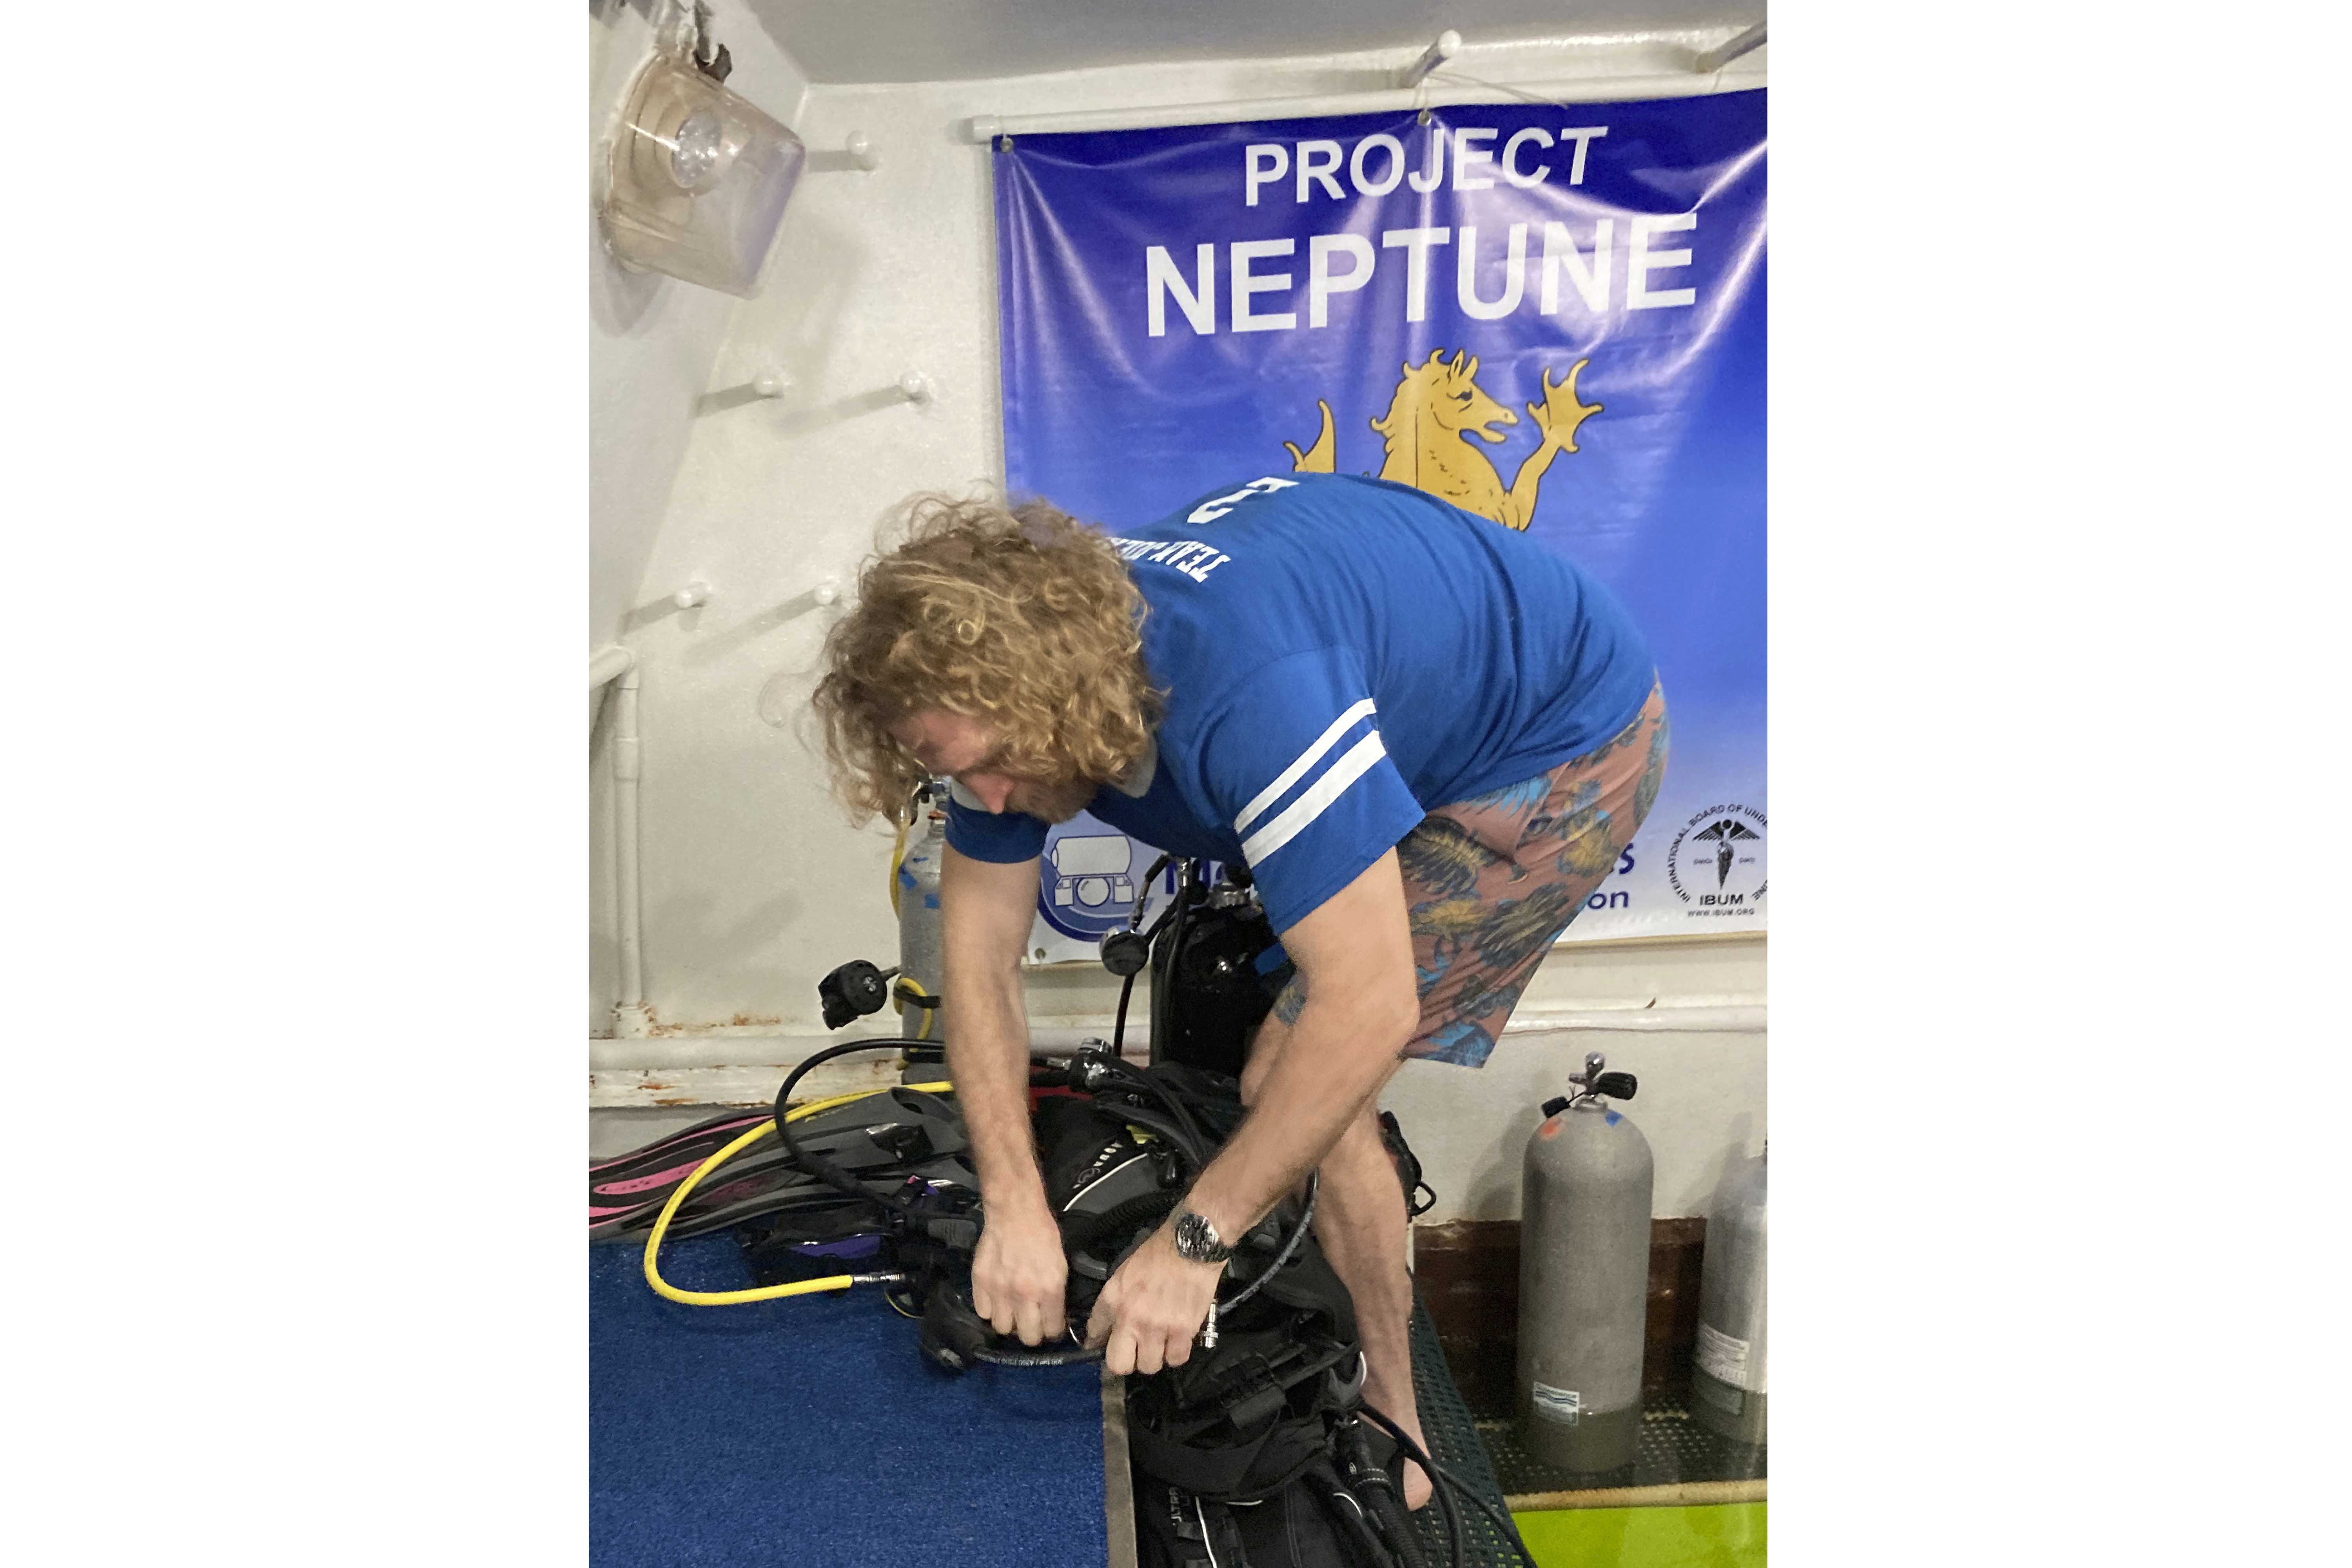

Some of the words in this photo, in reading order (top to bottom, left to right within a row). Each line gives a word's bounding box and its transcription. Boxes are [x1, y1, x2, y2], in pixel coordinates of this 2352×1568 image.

[1245, 126, 1608, 206] PROJECT
[1146, 213, 1698, 337] NEPTUNE
[1668, 828, 1690, 903] INTERNATIONAL
[1688, 804, 1725, 827] BOARD
[1727, 804, 1744, 812] OF
[1699, 894, 1744, 905] IBUM
